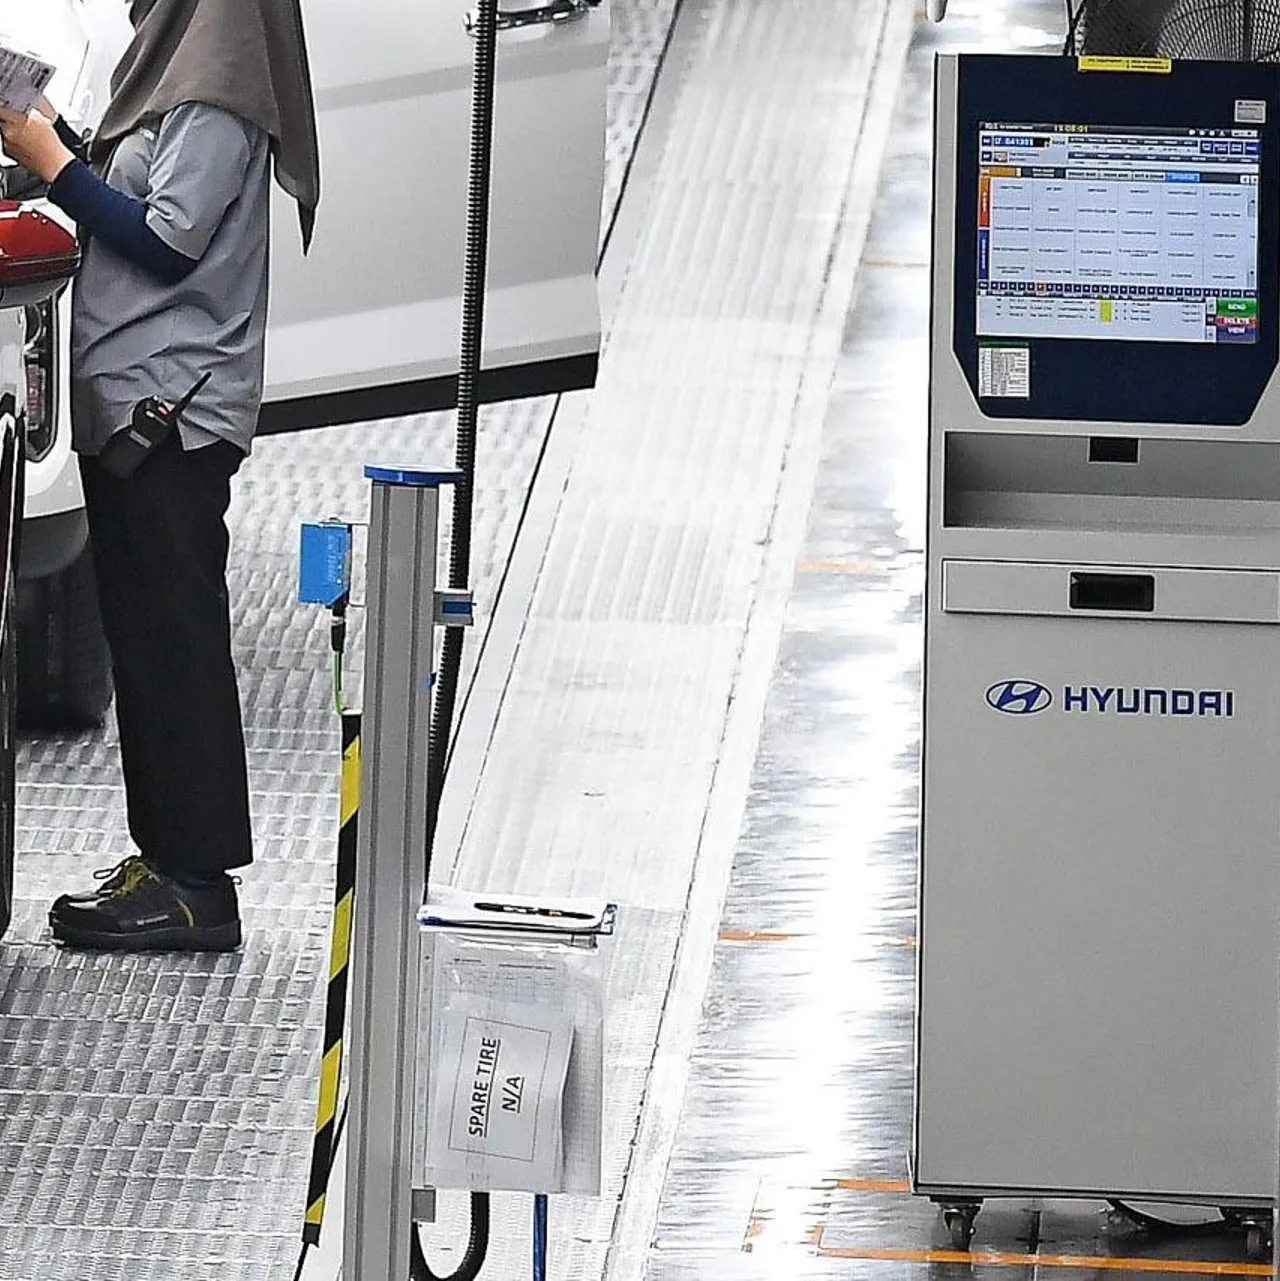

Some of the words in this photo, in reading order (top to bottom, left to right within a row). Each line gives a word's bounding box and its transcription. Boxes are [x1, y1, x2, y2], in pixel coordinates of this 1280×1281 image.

[1064, 686, 1233, 716] HYUNDAI
[476, 1037, 497, 1076] TIRE
[468, 1080, 489, 1138] SPARE
[501, 1076, 521, 1112] N/A
